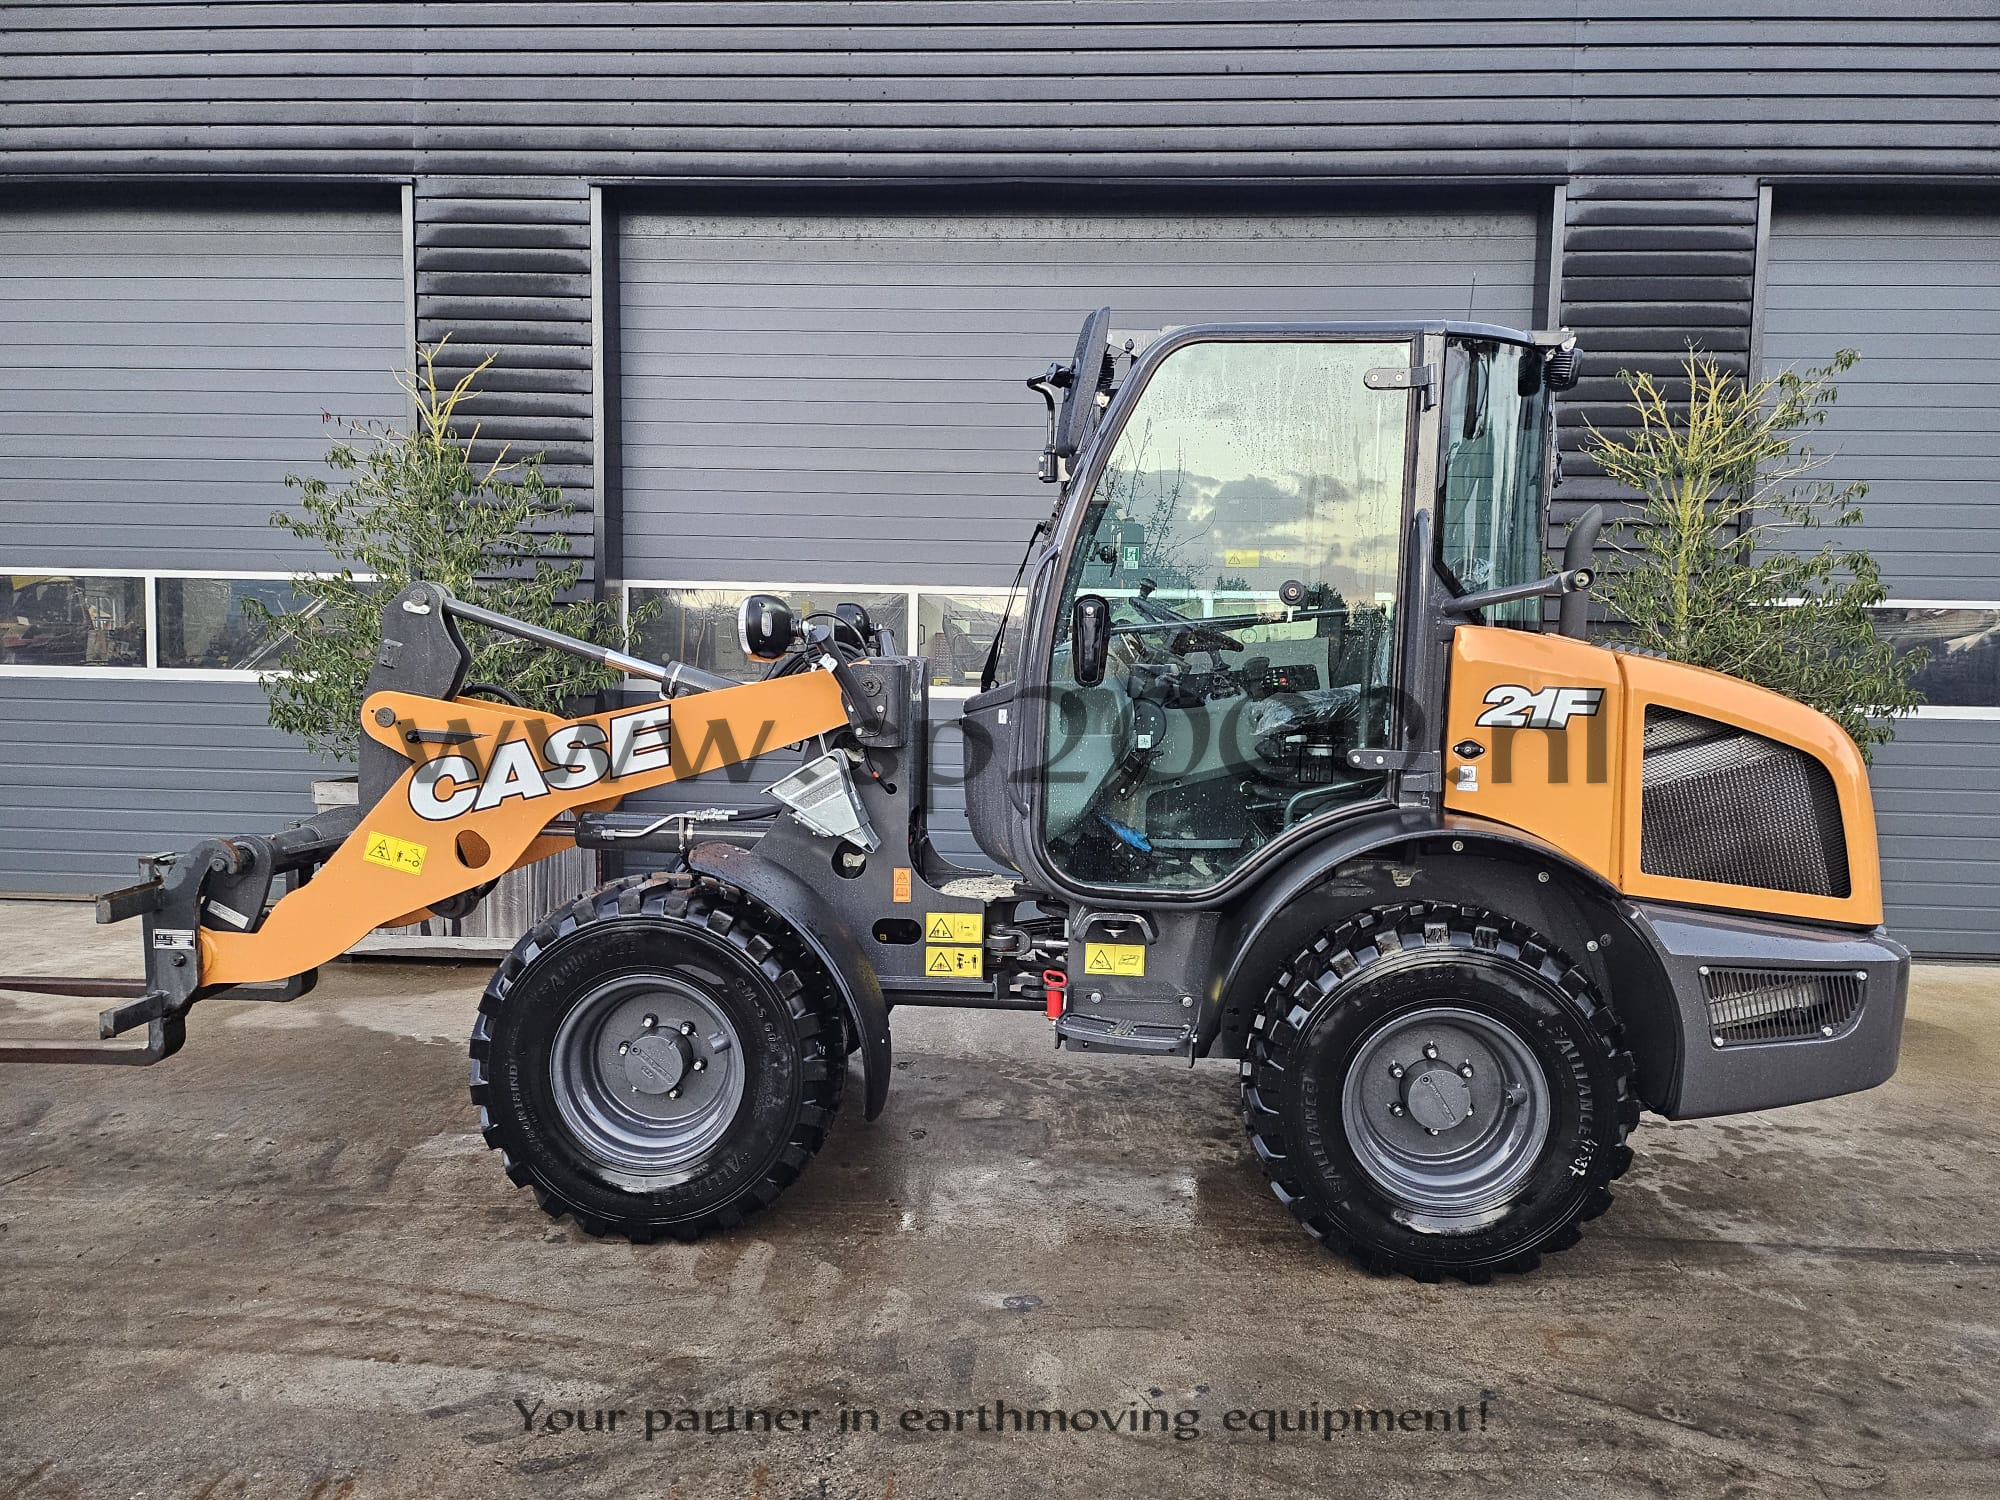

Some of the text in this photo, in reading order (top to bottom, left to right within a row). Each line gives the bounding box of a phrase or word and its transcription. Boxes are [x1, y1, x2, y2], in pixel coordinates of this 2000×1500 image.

[1475, 684, 1605, 730] 21F
[409, 704, 671, 821] CASE
[1555, 1038, 1594, 1135] ALLIANCE
